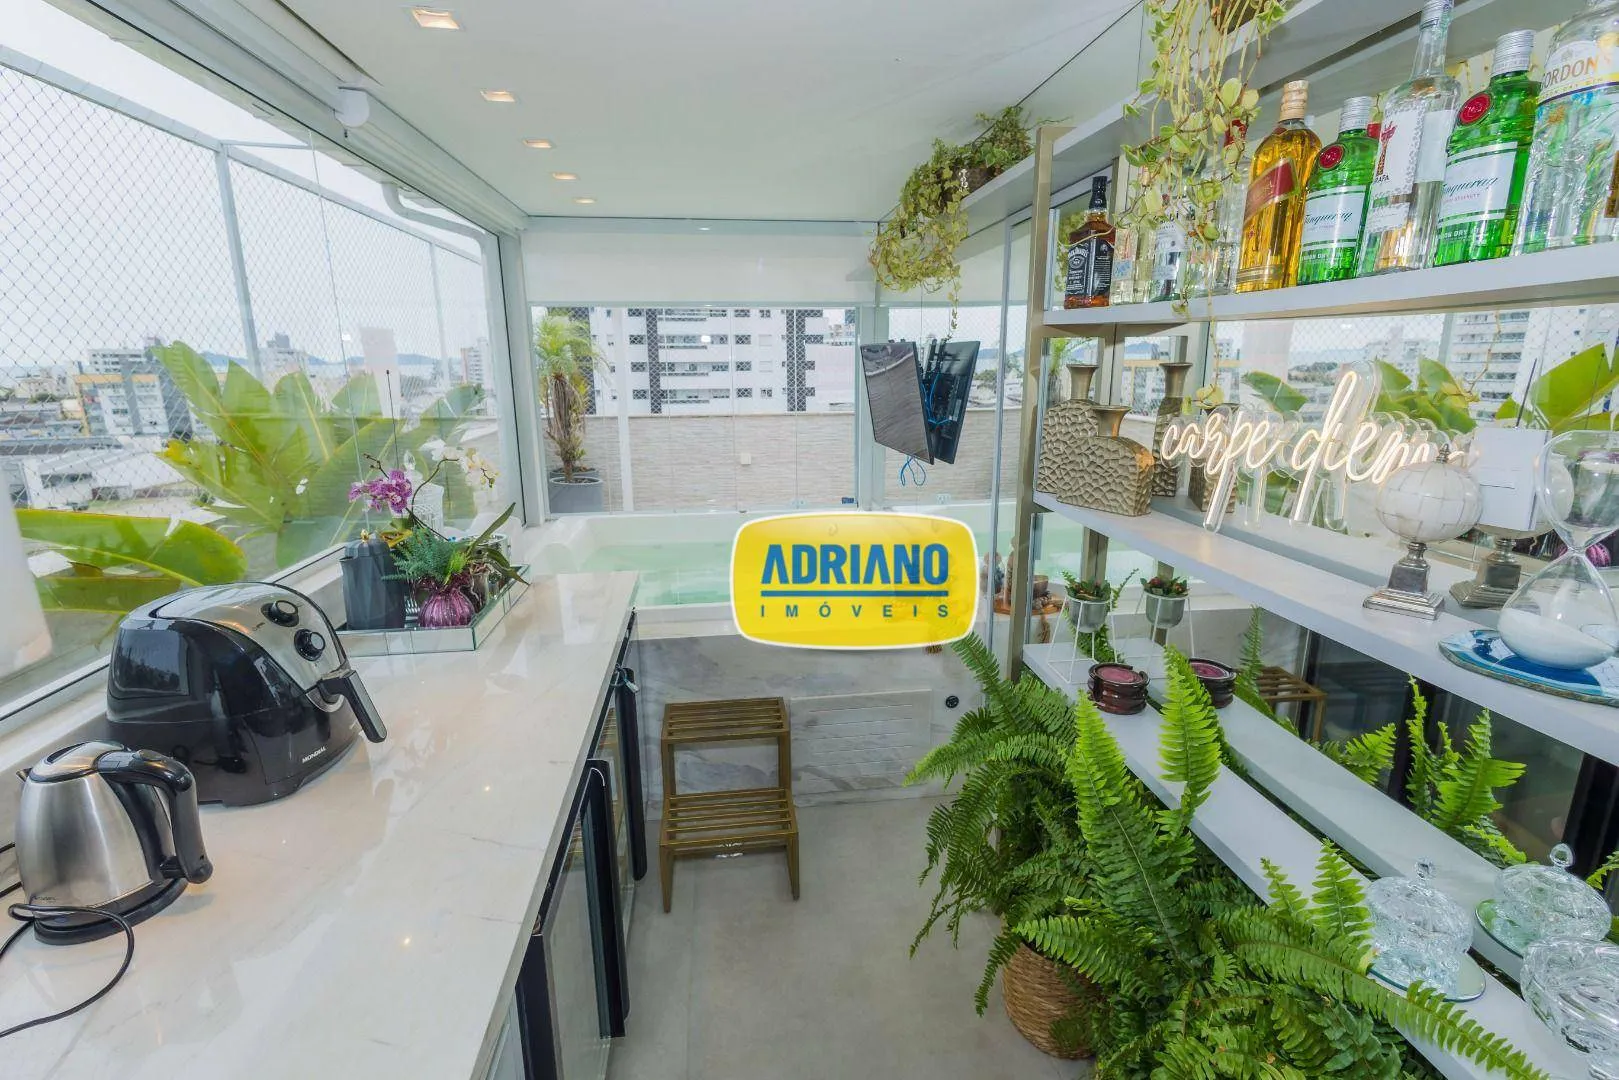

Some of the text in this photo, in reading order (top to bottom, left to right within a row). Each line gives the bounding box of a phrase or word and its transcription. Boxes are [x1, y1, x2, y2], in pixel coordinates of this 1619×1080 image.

[1161, 370, 1465, 530] carpe diem
[302, 746, 327, 764] MONDIAL
